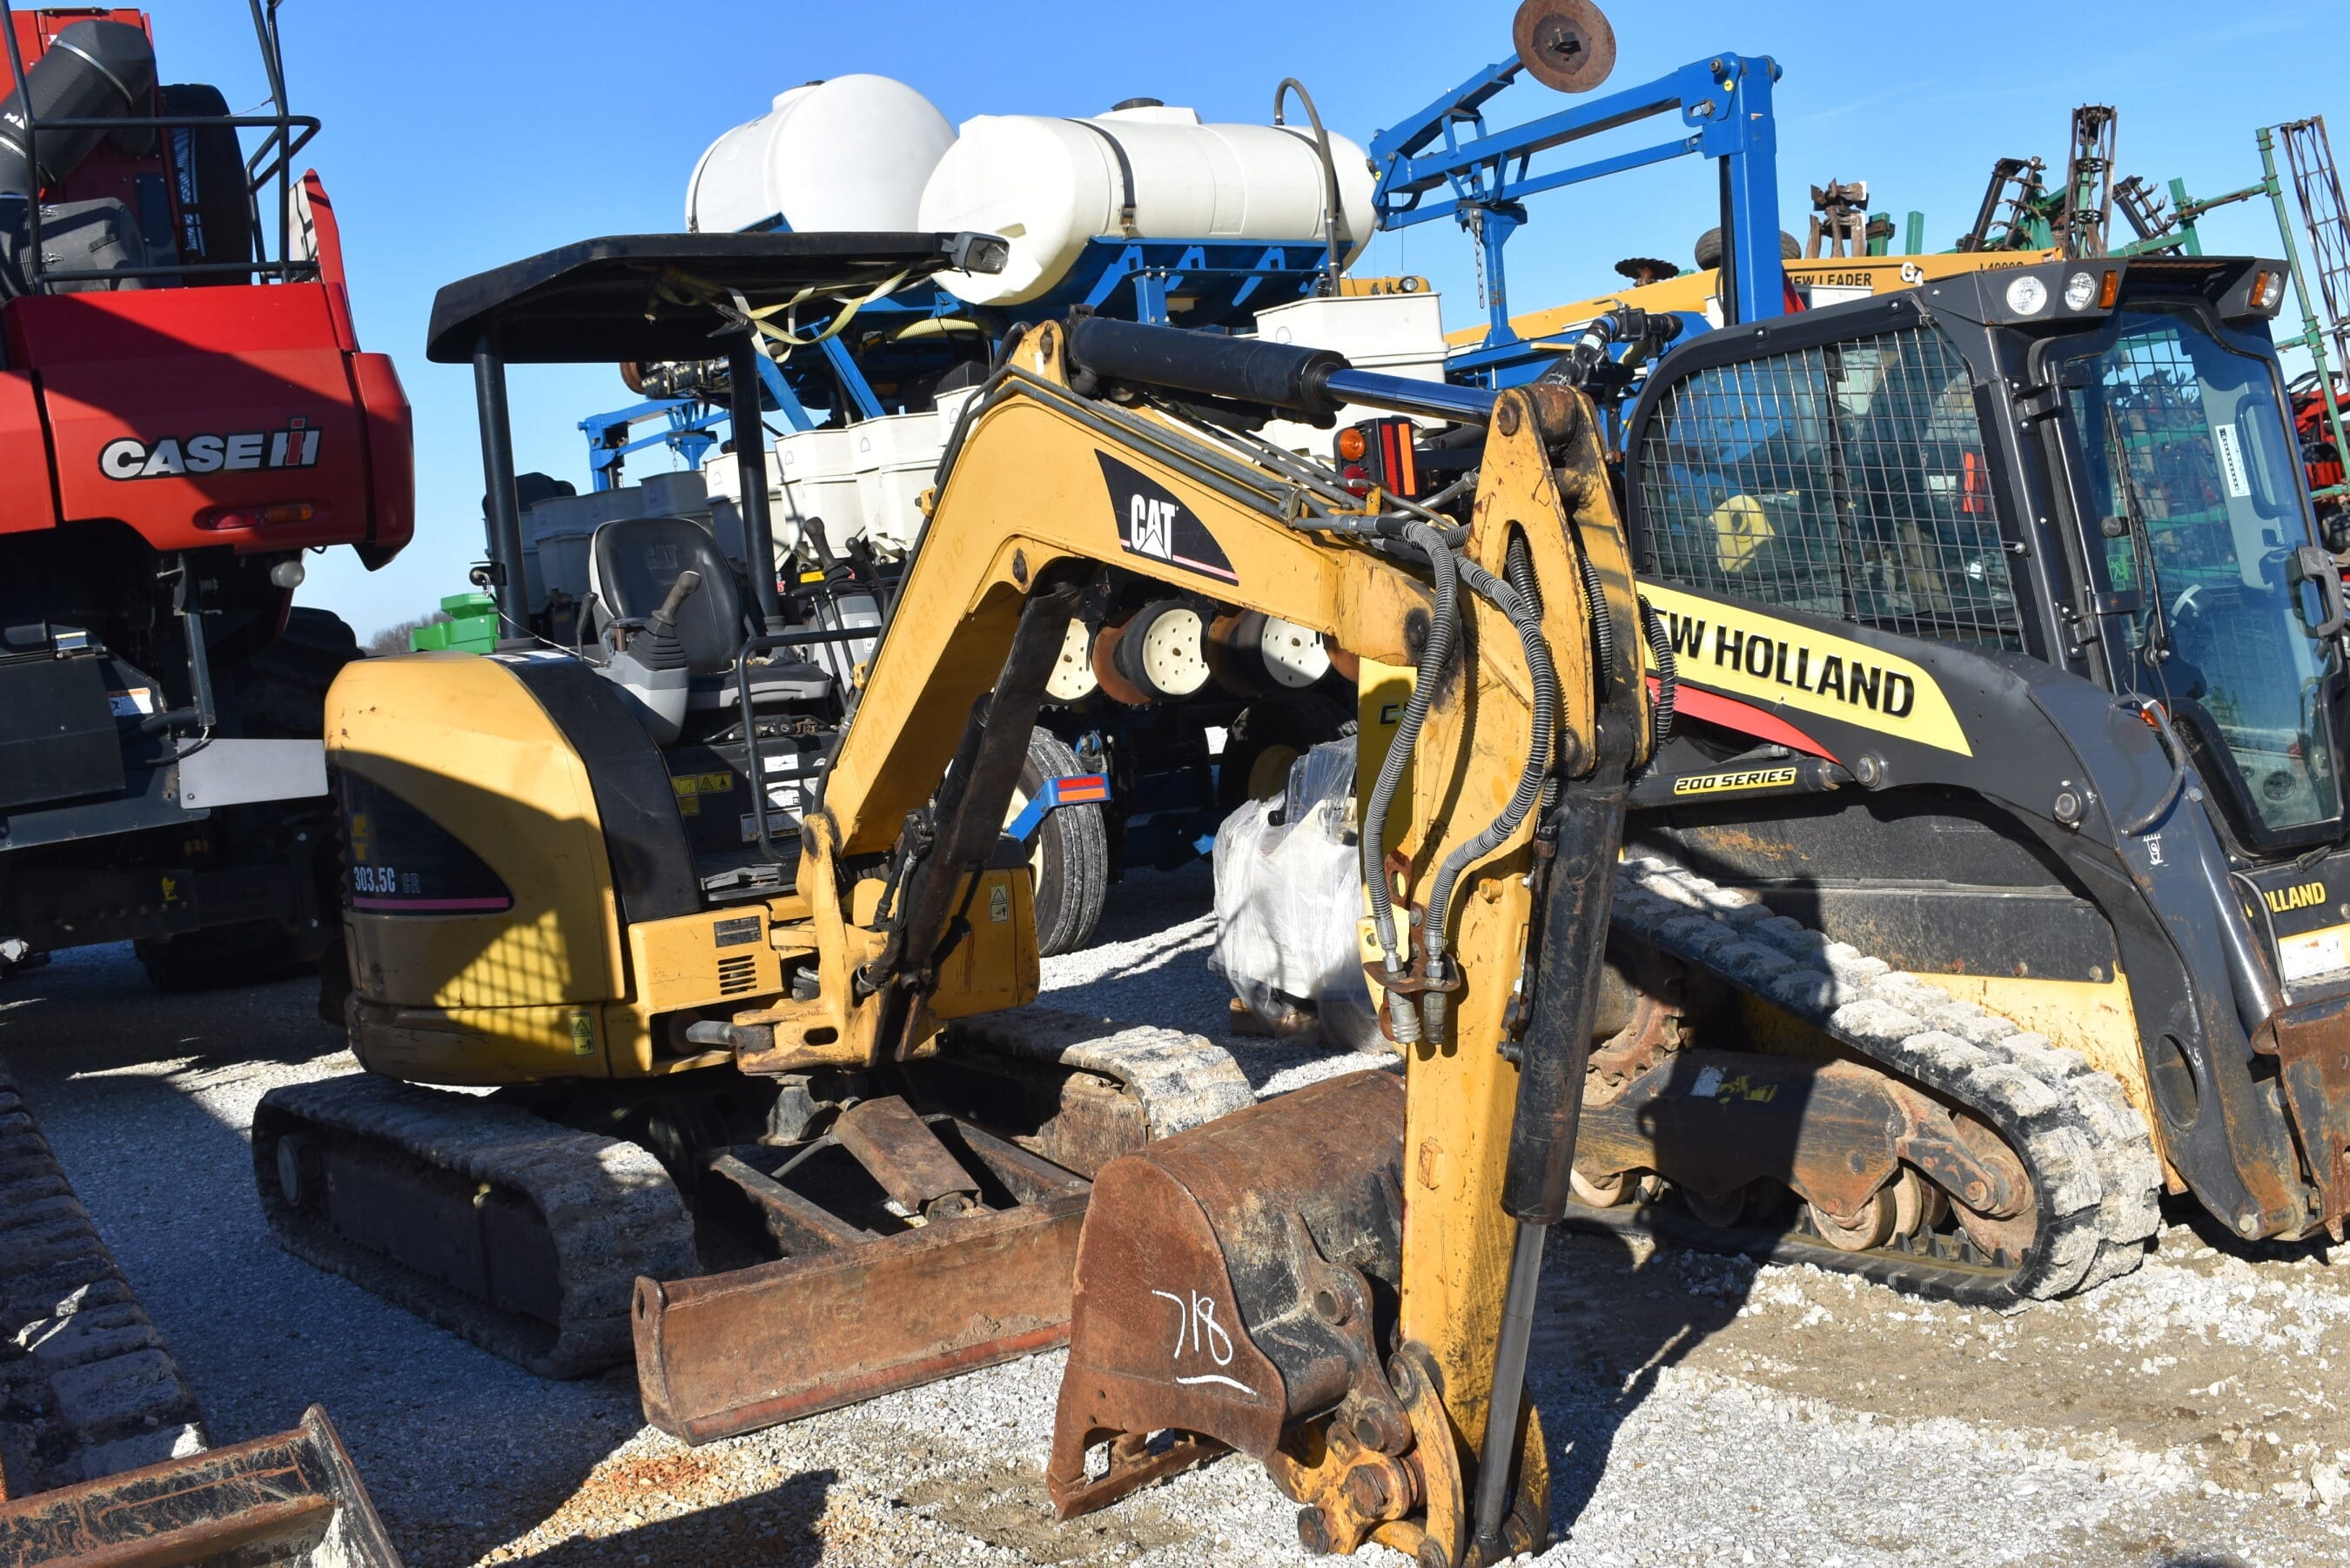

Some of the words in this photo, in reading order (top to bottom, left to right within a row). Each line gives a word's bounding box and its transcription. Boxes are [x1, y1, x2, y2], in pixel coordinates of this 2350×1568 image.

[101, 434, 263, 479] CASE
[1131, 493, 1175, 560] CAT
[1714, 624, 1916, 719] HOLLAND
[1675, 777, 1716, 792] 200
[1721, 769, 1795, 787] SERIES
[353, 866, 396, 893] 303.5C
